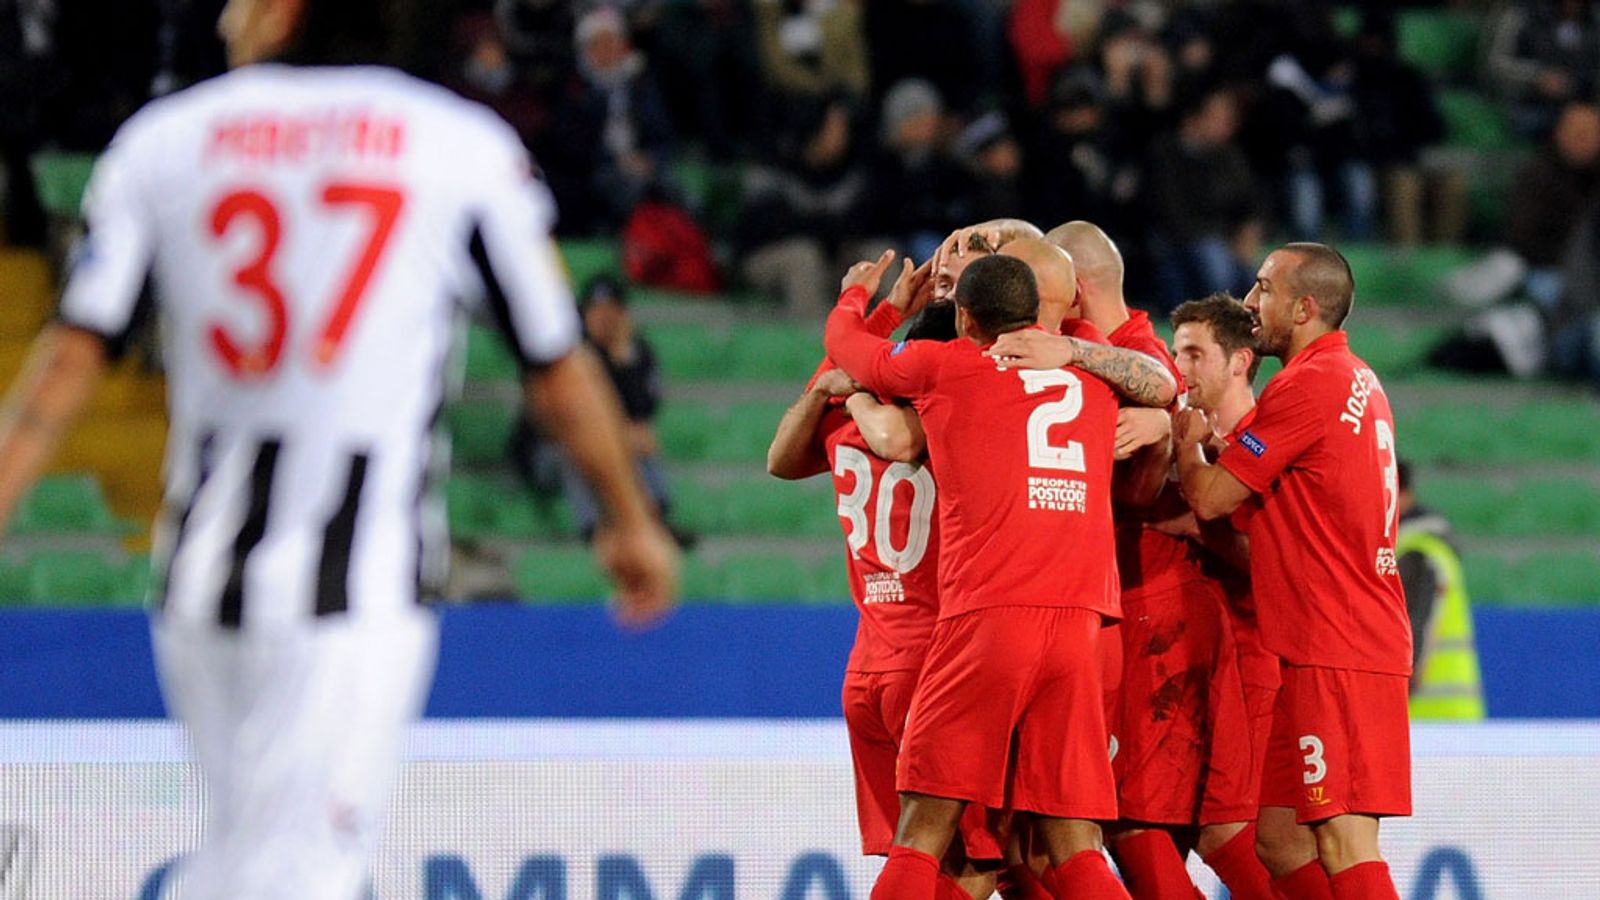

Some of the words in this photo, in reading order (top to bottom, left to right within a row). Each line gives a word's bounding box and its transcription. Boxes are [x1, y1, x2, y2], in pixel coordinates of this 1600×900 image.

[211, 186, 404, 377] 37
[1018, 368, 1087, 473] 2
[1375, 419, 1398, 538] 3
[834, 444, 936, 574] 30
[1299, 735, 1327, 785] 3
